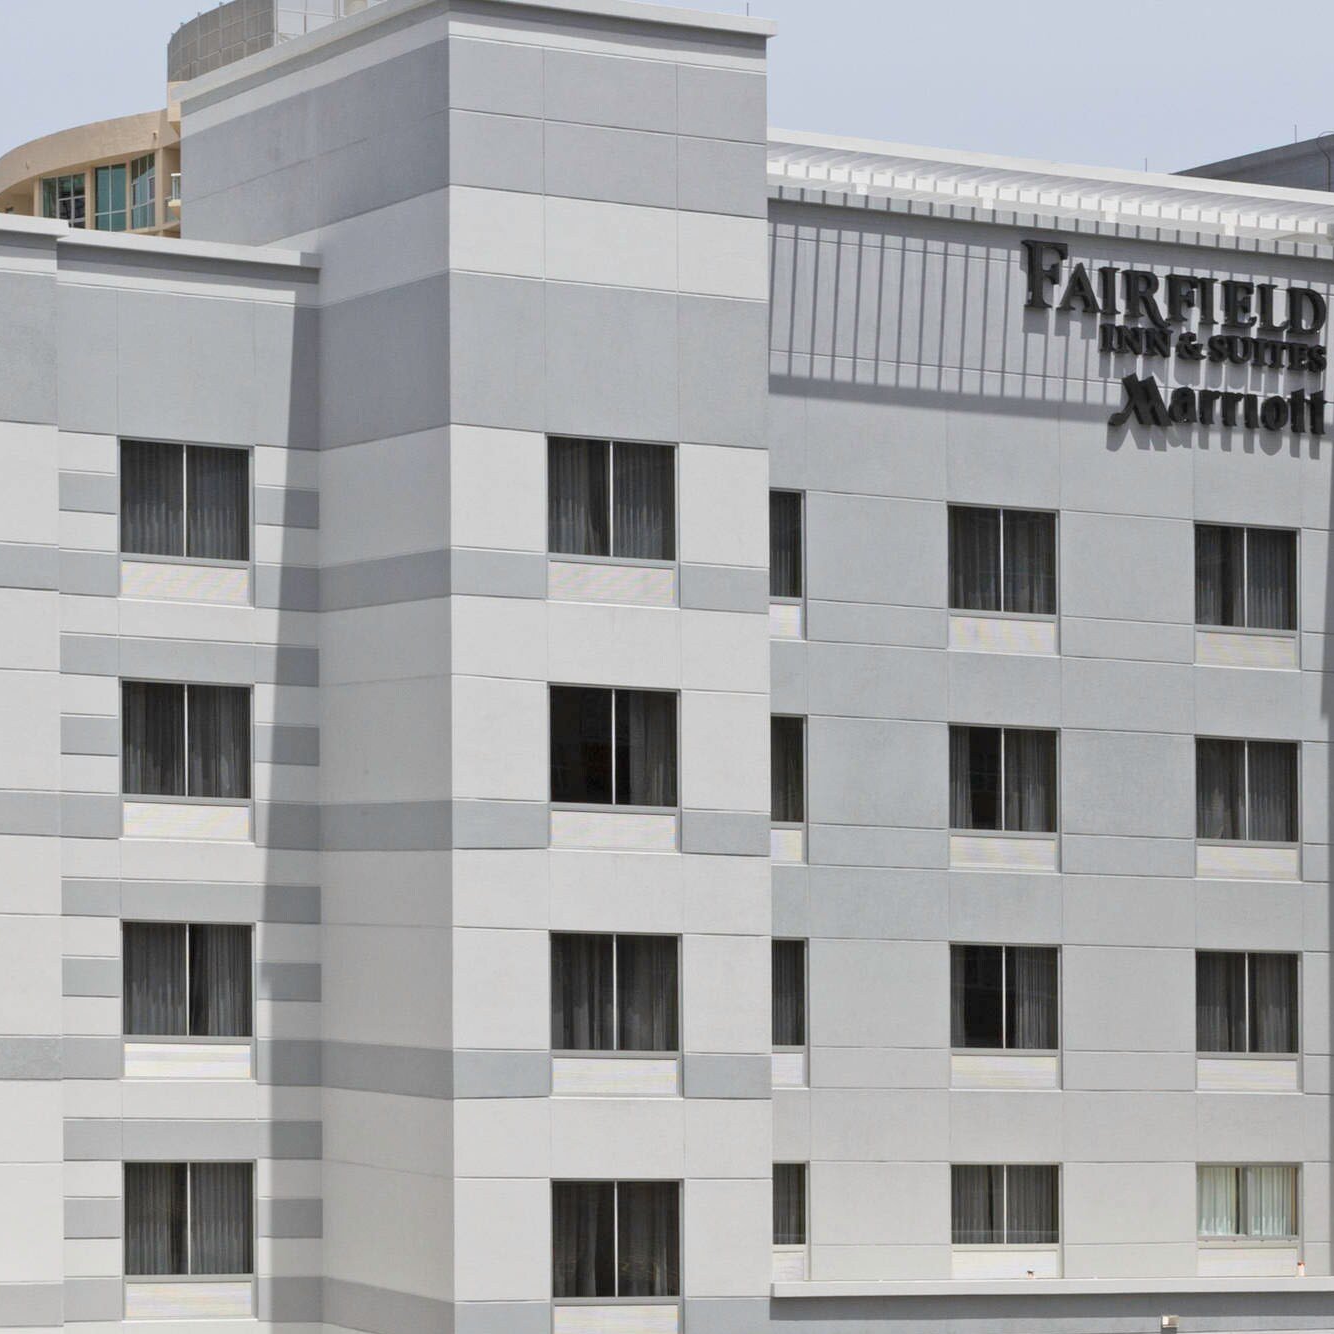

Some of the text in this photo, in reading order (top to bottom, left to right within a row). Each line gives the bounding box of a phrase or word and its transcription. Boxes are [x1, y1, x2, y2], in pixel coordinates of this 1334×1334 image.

[1021, 239, 1327, 335] FAIRFIELD
[1099, 323, 1327, 373] INN & SUITES
[1107, 373, 1327, 435] Marriott
